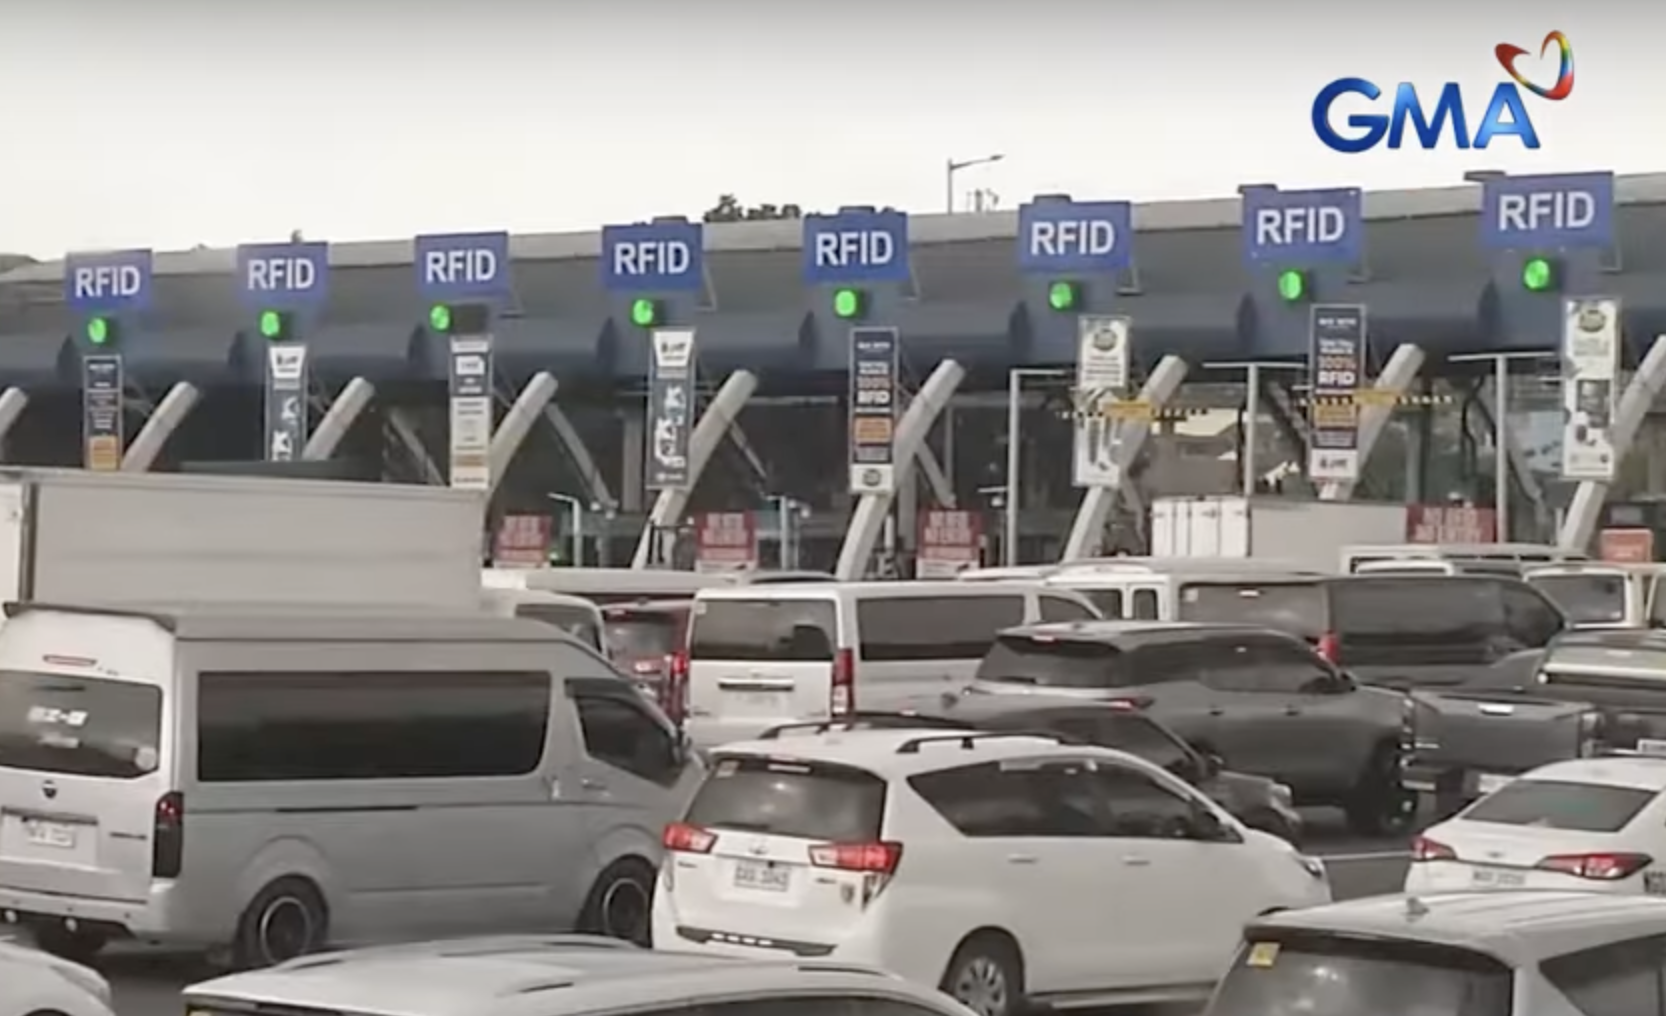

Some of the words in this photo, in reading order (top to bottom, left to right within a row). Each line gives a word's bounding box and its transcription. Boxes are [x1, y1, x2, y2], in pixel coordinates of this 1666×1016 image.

[1256, 206, 1346, 245] RFID
[1498, 191, 1596, 231] RFID
[815, 231, 894, 266] RFID
[1030, 220, 1116, 256] RFID
[246, 257, 315, 290] RFID
[425, 249, 497, 283] RFID
[614, 241, 690, 274] RFID
[75, 265, 141, 298] RFID
